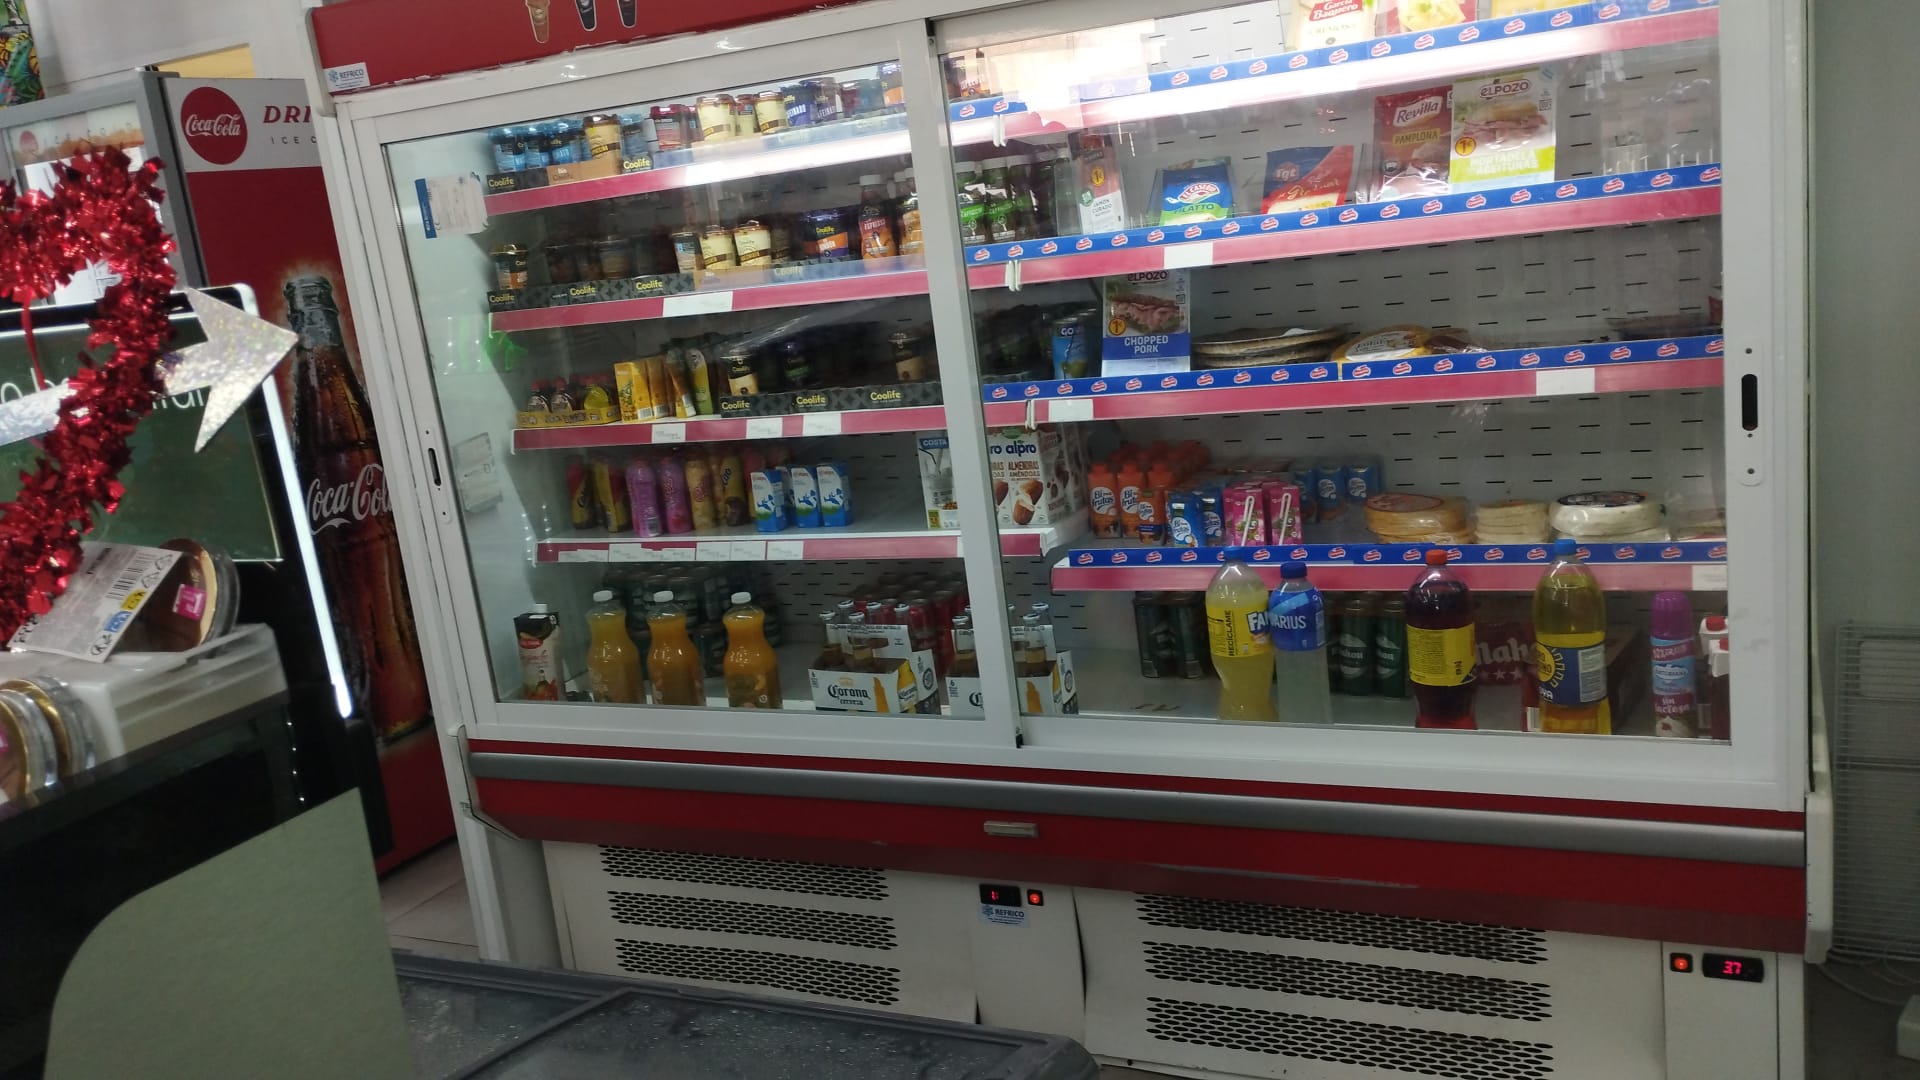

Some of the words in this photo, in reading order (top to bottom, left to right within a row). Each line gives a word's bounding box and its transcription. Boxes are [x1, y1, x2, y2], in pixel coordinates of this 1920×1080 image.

[1396, 100, 1440, 124] Revilla
[185, 113, 241, 137] Coca-Cola
[270, 136, 300, 145] ICE
[1394, 131, 1439, 144] PAMPLONA
[624, 158, 651, 170] Coolife
[488, 177, 515, 188] Coolife
[569, 286, 596, 296] Coolife
[635, 280, 663, 291] Coolife
[489, 294, 516, 304] Coolife
[1124, 335, 1169, 346] CHOPPED
[1134, 344, 1159, 354] PORK
[796, 395, 826, 407] Coolife
[870, 391, 901, 402] Coolife
[721, 401, 750, 411] Coolife
[922, 439, 948, 448] COSTA
[1005, 441, 1037, 457] alpro
[827, 684, 872, 700] Corona
[994, 908, 1025, 918] REFRICO
